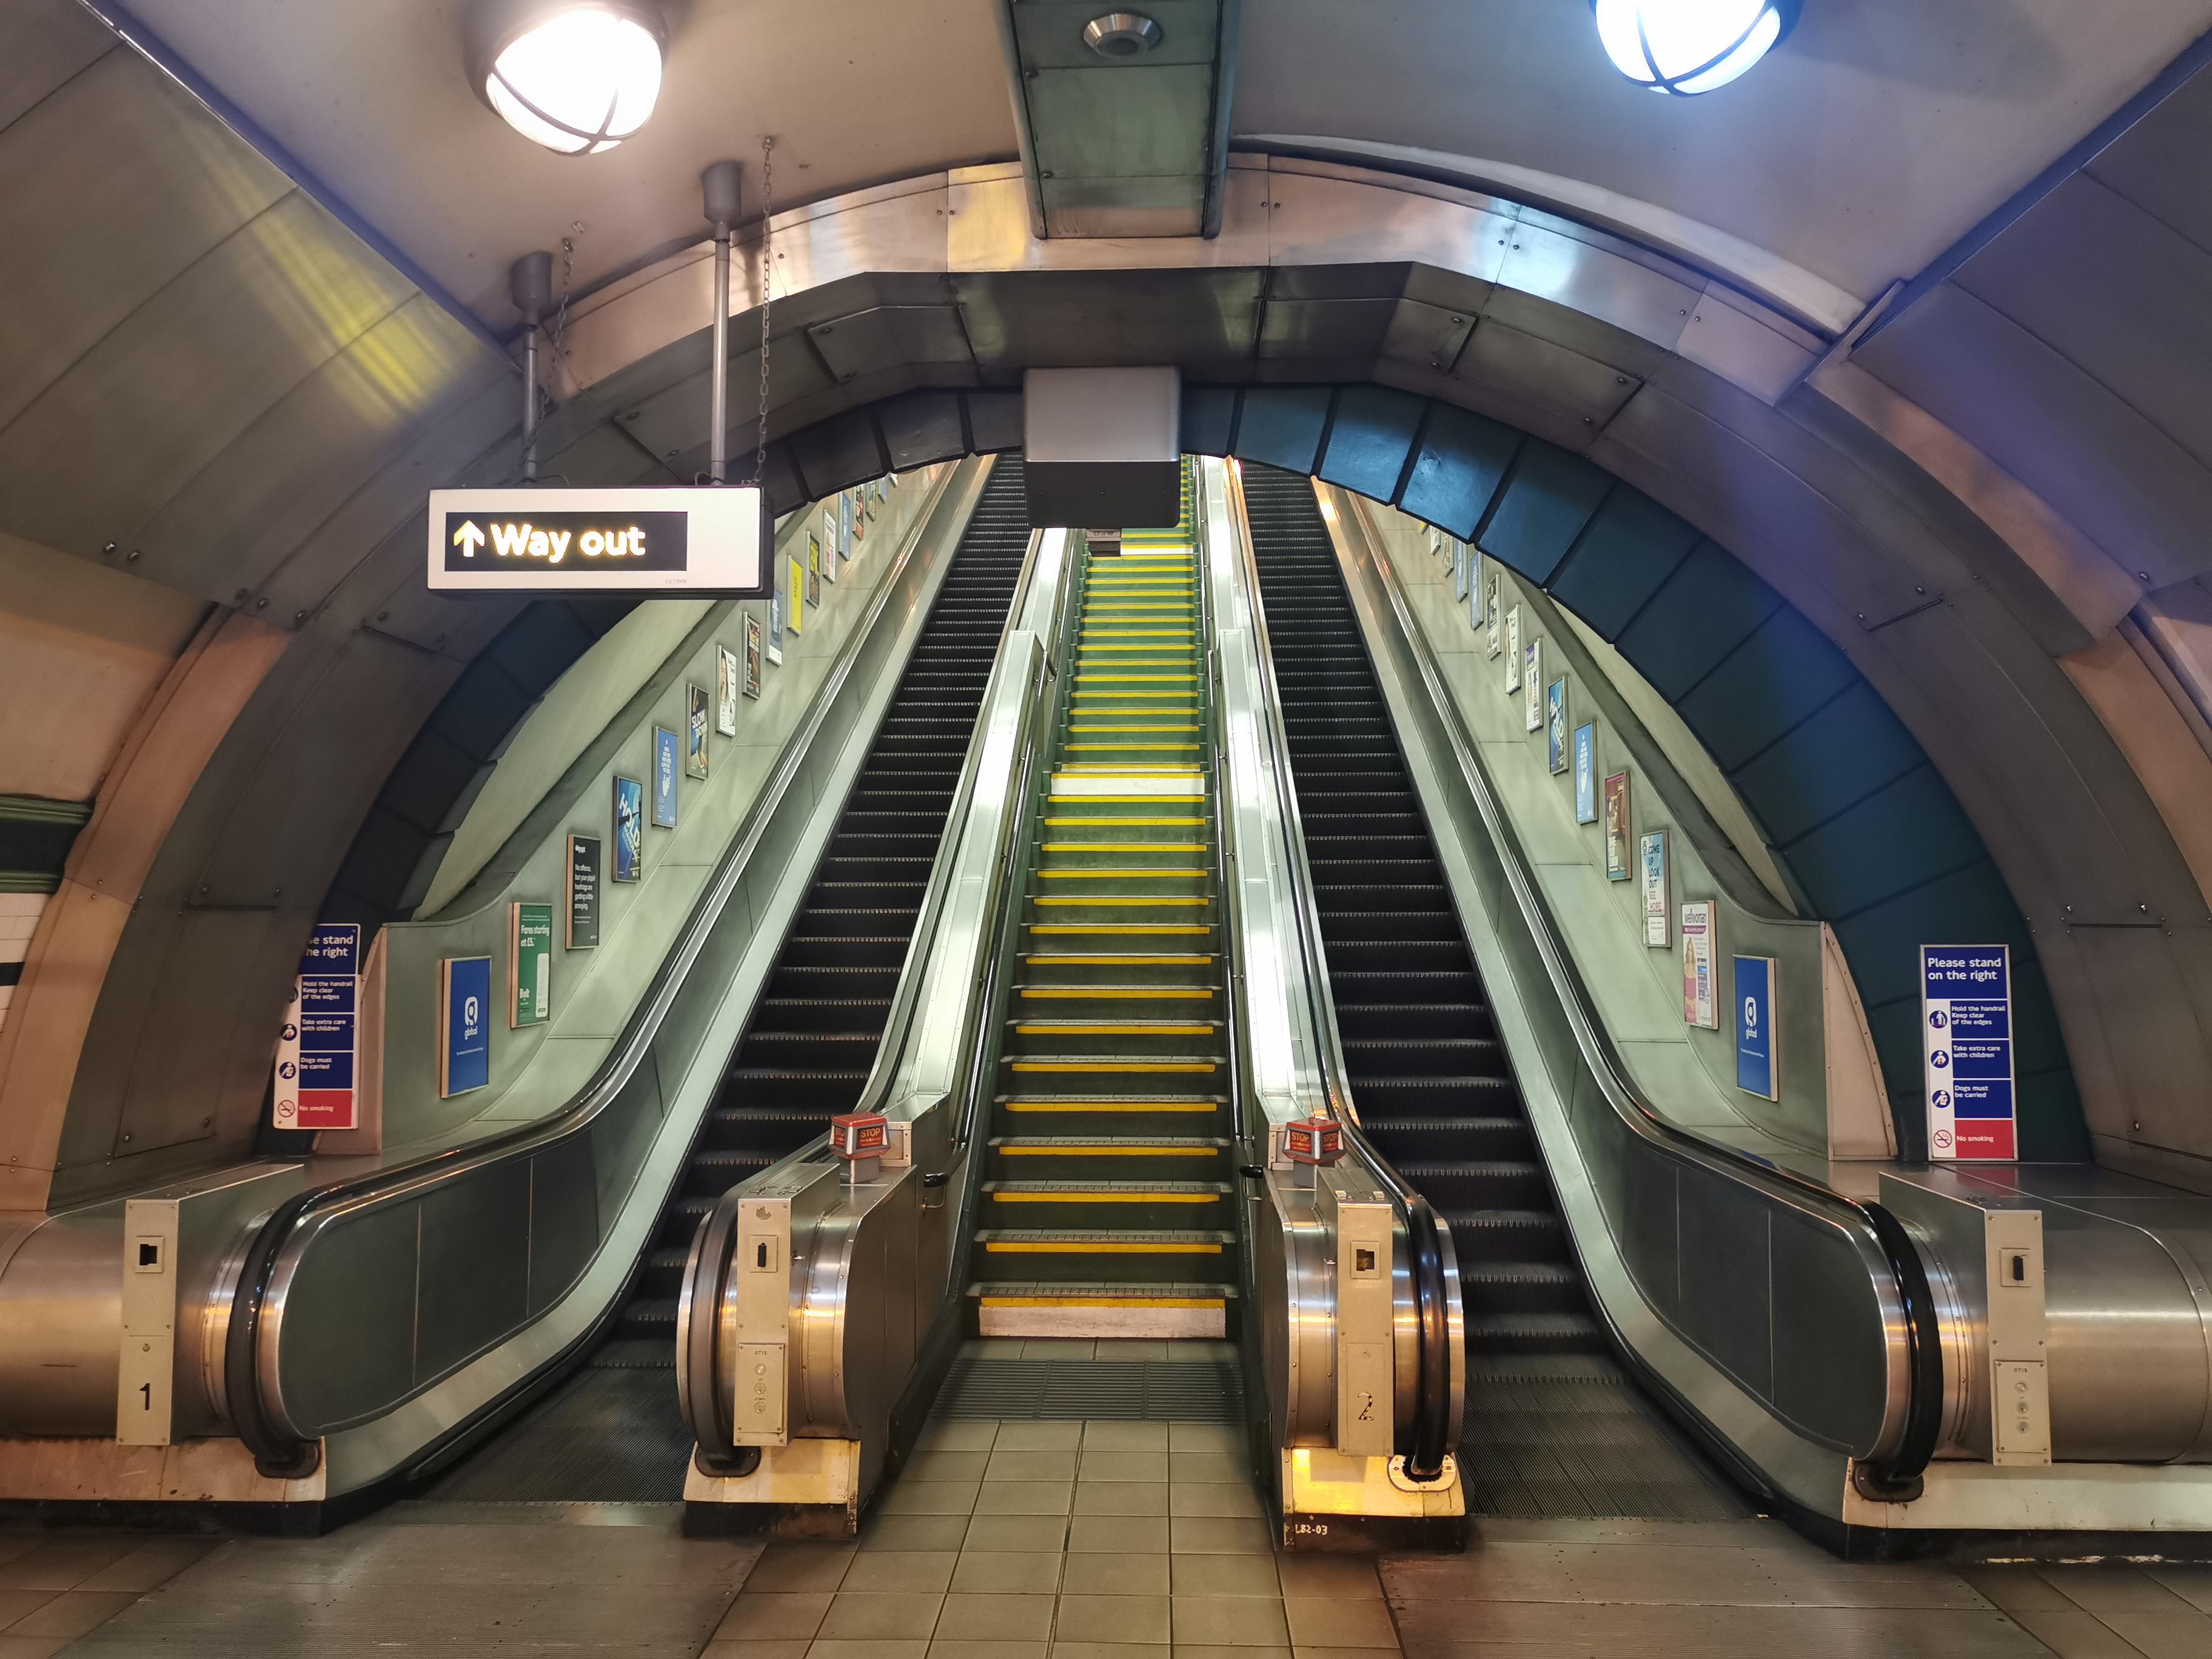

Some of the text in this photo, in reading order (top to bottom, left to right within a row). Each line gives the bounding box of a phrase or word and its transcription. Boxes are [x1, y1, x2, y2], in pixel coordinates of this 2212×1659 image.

[489, 523, 646, 564] Way out
[521, 924, 550, 937] Fares starting
[323, 935, 354, 945] stand
[520, 938, 526, 947] at
[323, 947, 349, 959] right
[1928, 957, 2002, 968] Please stand
[1946, 970, 1967, 980] the
[1970, 970, 1998, 982] right
[520, 988, 530, 999] Bolt
[464, 1025, 478, 1040] global
[1746, 1027, 1757, 1040] global
[835, 1127, 845, 1136] STO
[860, 1127, 881, 1138] STOP
[1292, 1131, 1310, 1142] STOP
[1323, 1132, 1337, 1142] STOP
[139, 1382, 151, 1411] 1
[1357, 1391, 1375, 1421] 2
[1295, 1524, 1328, 1536] L82-03
